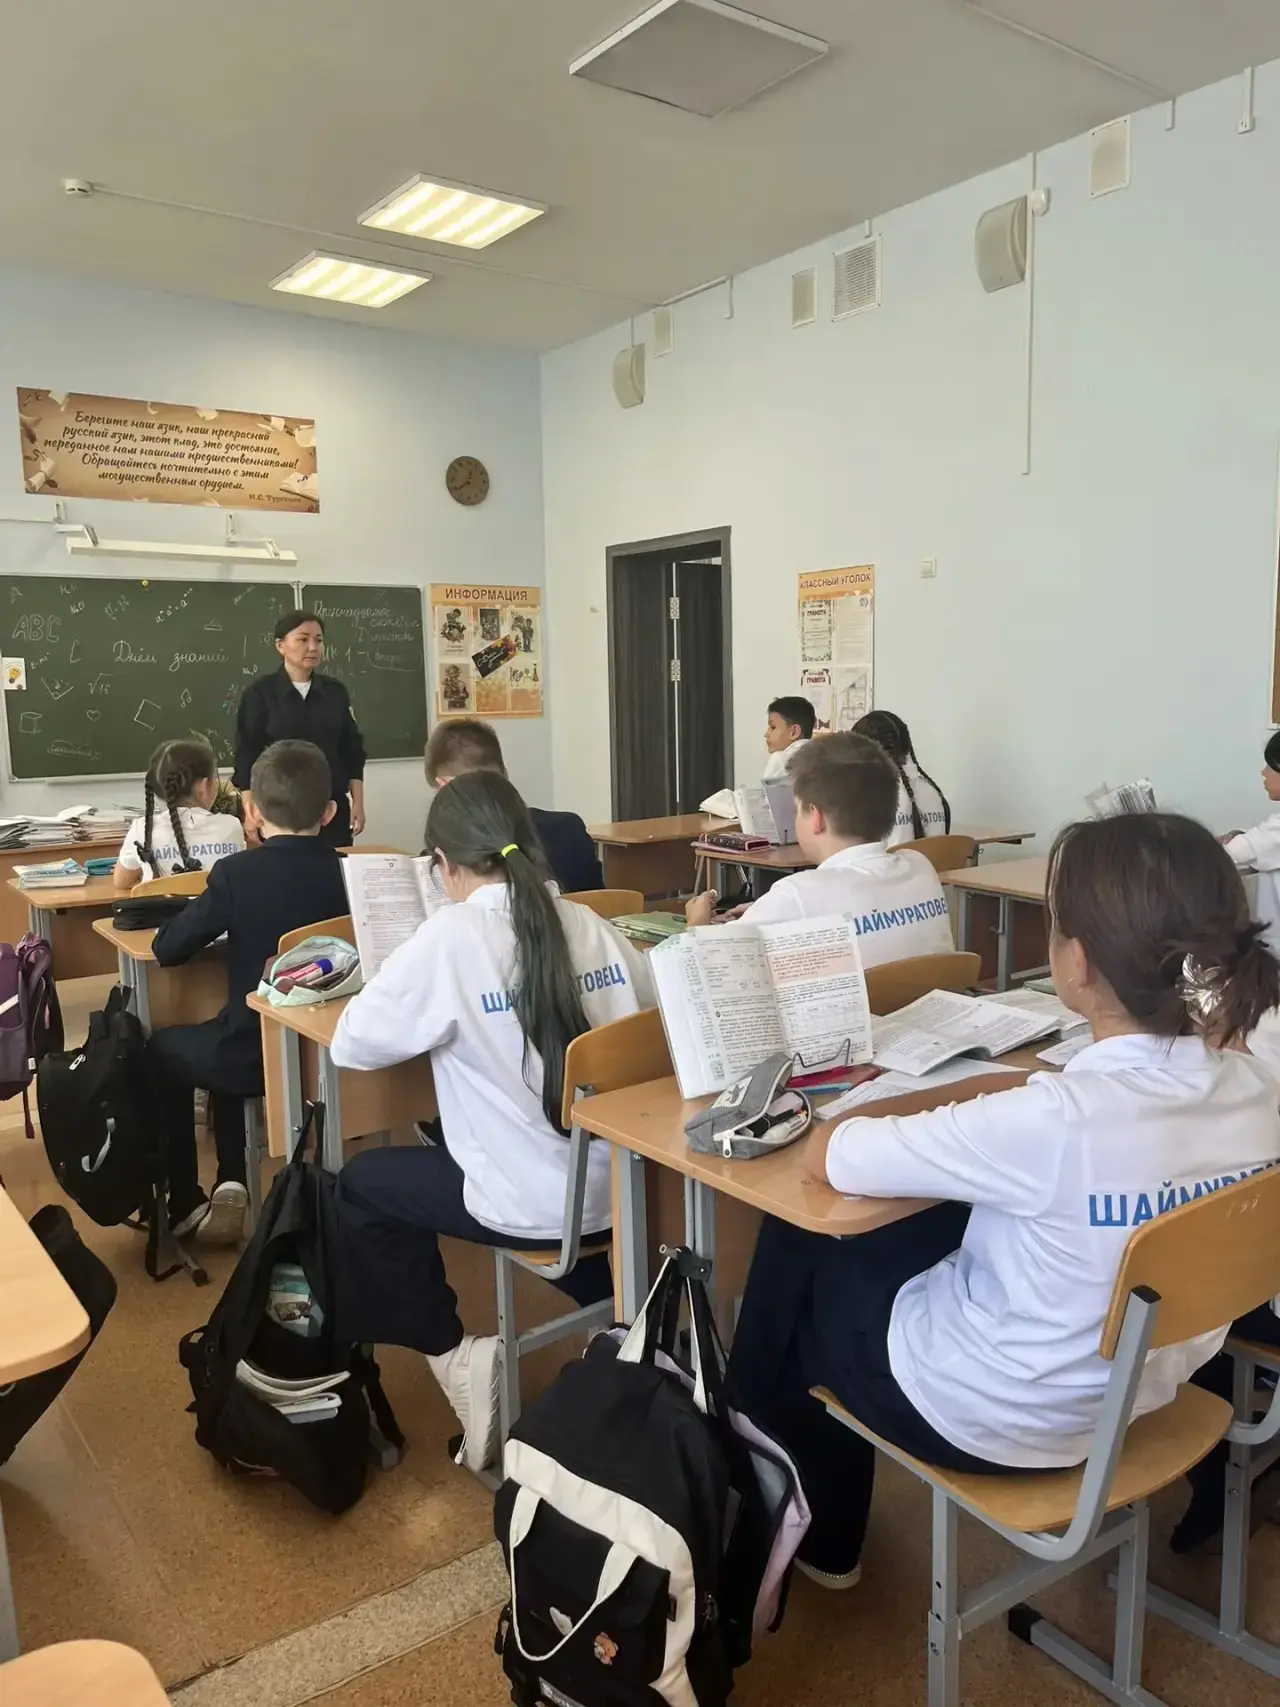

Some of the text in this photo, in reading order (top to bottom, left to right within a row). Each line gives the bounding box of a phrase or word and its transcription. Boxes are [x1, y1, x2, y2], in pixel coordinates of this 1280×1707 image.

[75, 410, 129, 427] Берегите
[131, 419, 155, 430] наш
[186, 425, 209, 434] наш
[43, 439, 110, 453] переданное
[113, 444, 137, 455] нам
[140, 447, 185, 459] нашими
[62, 426, 109, 440] русский
[140, 434, 171, 445] этот
[203, 439, 222, 450] это
[224, 441, 281, 456] достояние,
[81, 452, 158, 469] Обращайтесь
[160, 462, 231, 476] почтительно
[240, 469, 269, 479] этим
[98, 471, 245, 493] могущественным орудием.
[841, 572, 871, 584] УГОЛОК
[445, 588, 528, 602] ИНФОРМАЦИЯ
